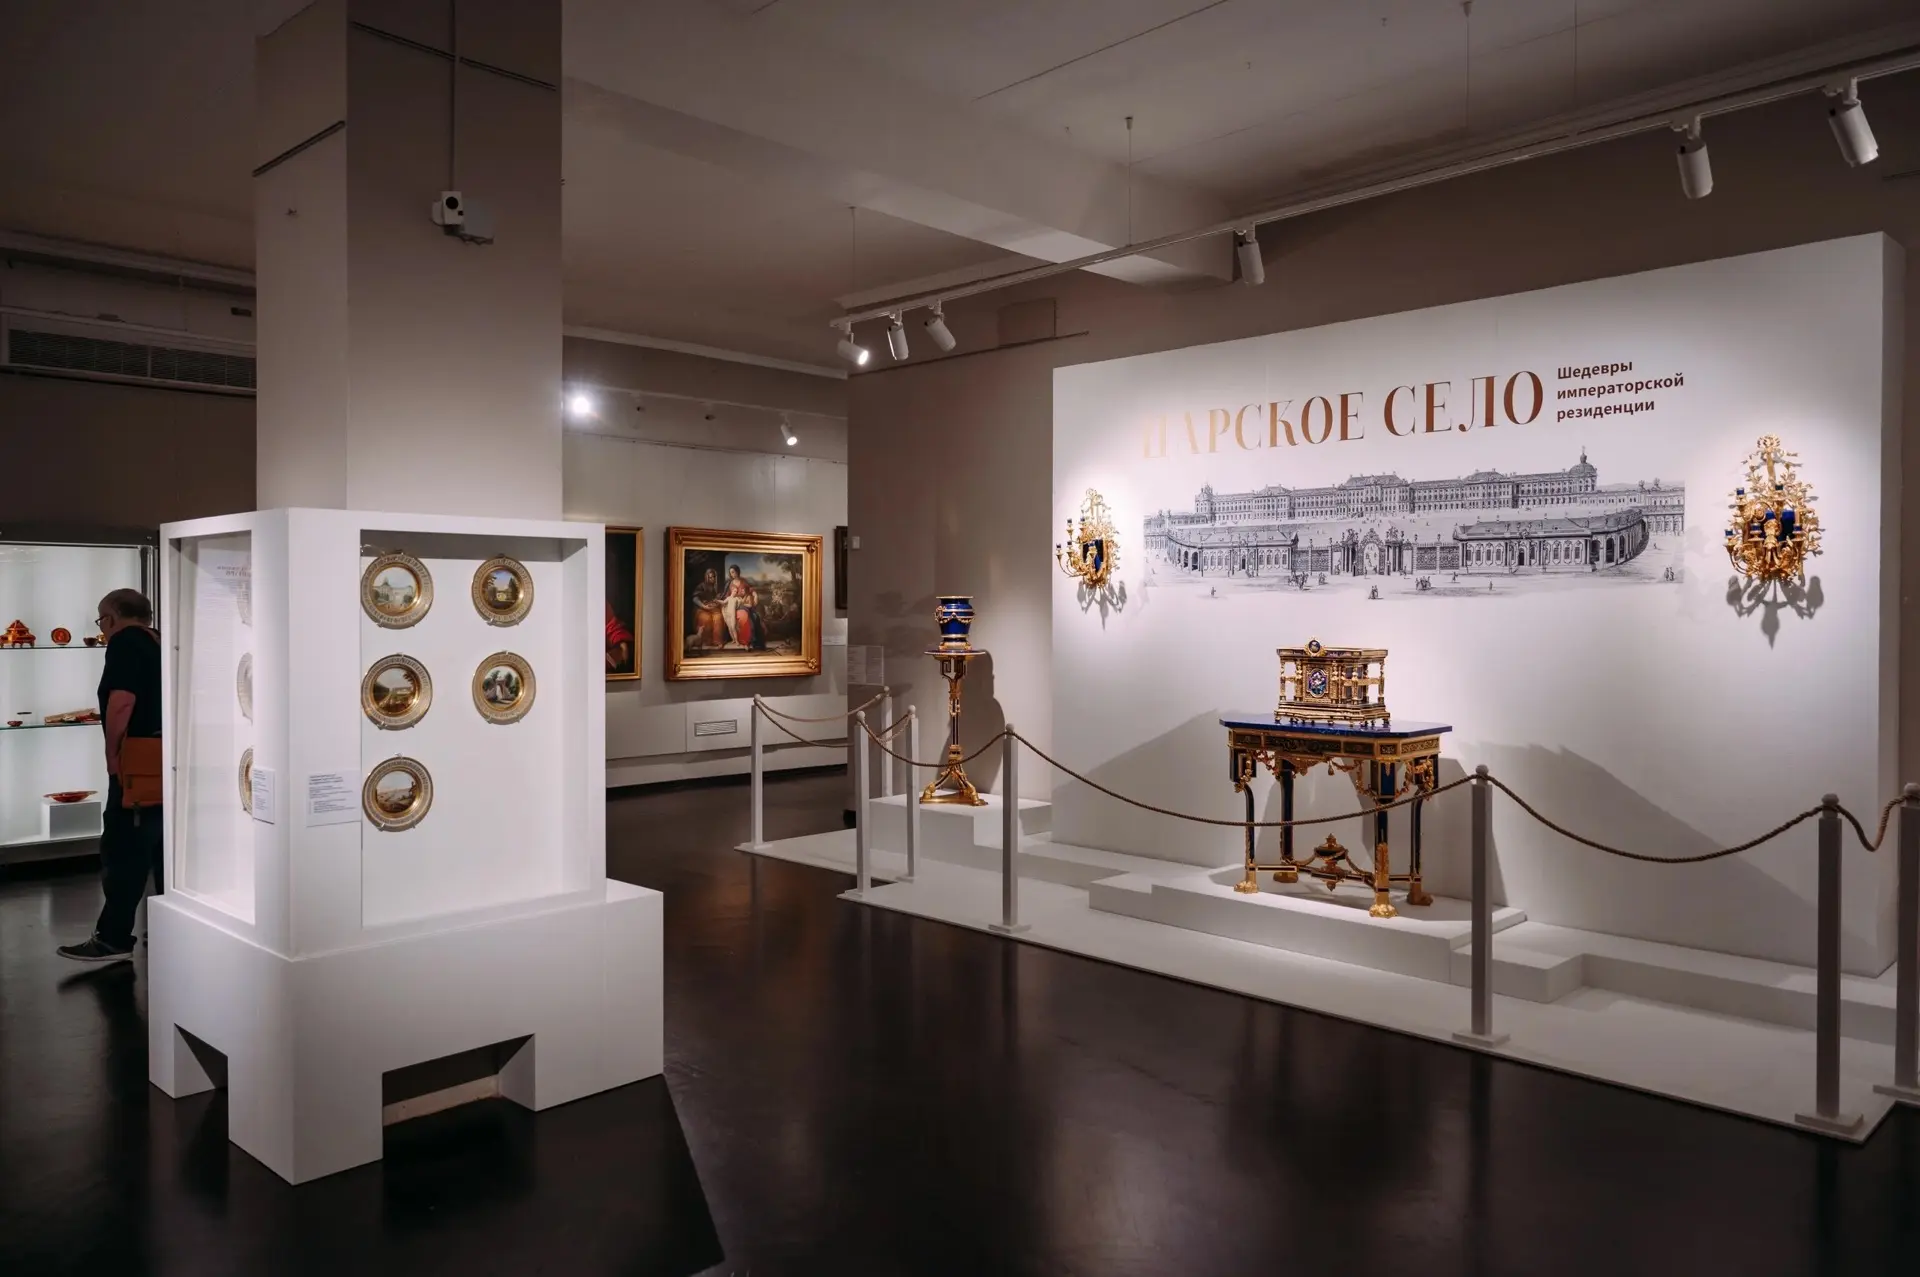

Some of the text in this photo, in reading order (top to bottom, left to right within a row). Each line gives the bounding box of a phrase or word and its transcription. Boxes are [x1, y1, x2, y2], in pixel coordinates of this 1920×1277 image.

[1557, 360, 1633, 380] Шедевры
[1557, 372, 1685, 400] императорской
[1142, 370, 1545, 460] ЦАРСКОЕ СЕЛО
[1556, 400, 1656, 423] резиденции
